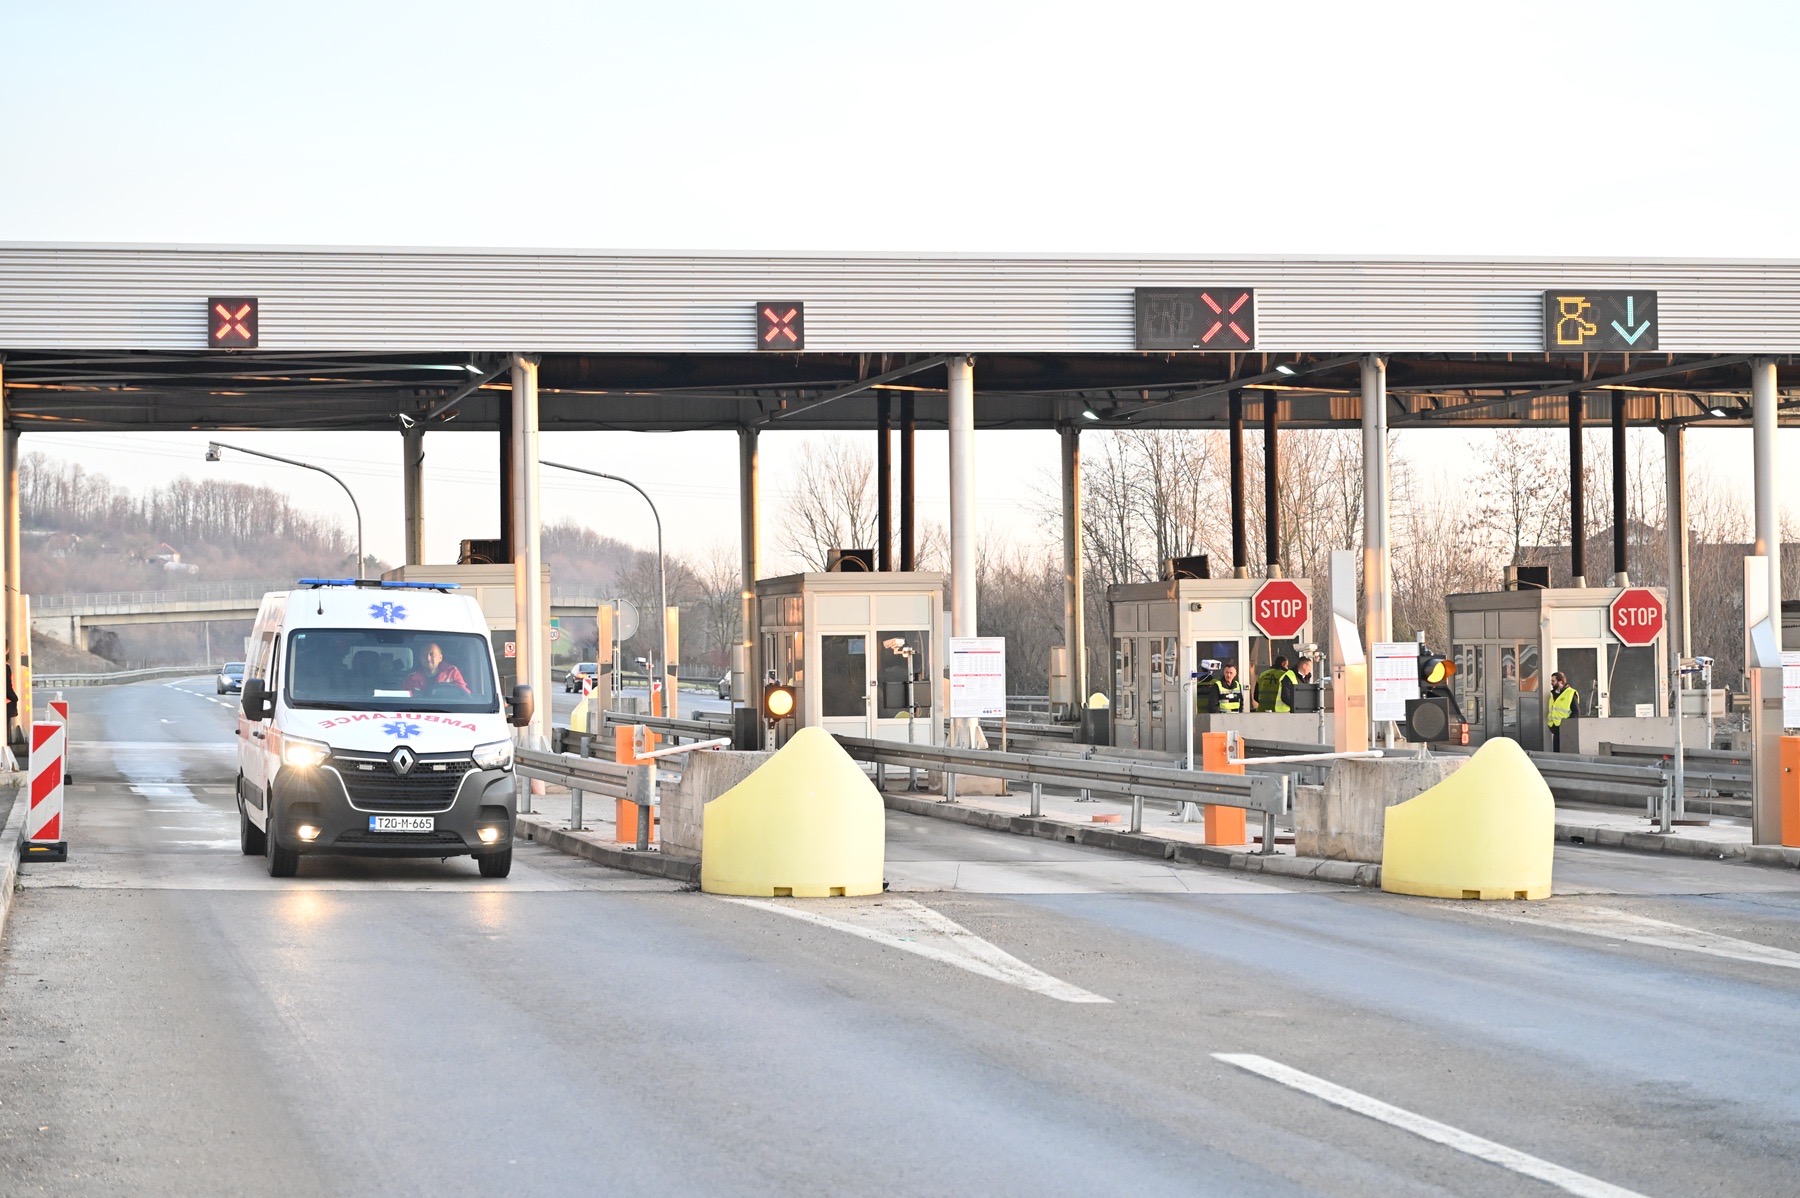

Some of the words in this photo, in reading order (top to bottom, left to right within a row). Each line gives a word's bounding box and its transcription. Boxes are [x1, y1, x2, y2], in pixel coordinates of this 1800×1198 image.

[1260, 599, 1302, 618] STOP
[1618, 607, 1658, 627] STOP
[378, 818, 432, 829] T20-M-665
